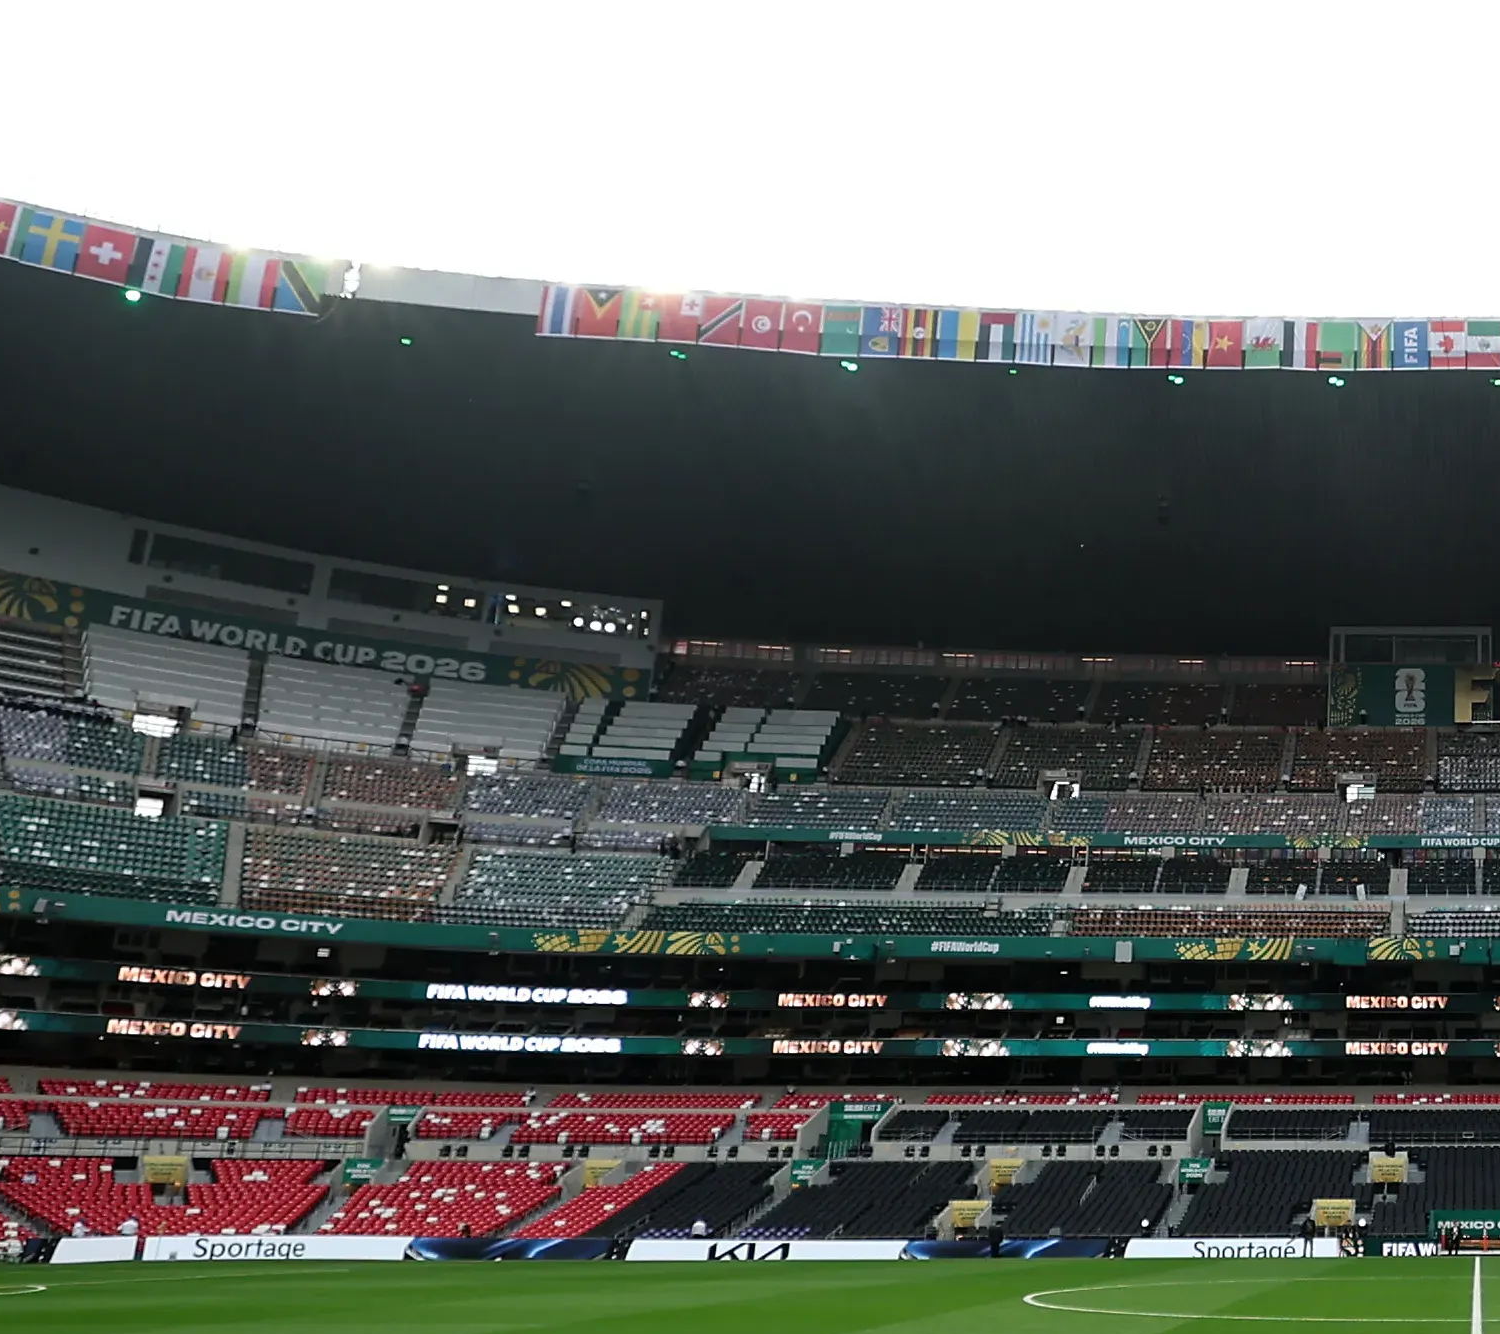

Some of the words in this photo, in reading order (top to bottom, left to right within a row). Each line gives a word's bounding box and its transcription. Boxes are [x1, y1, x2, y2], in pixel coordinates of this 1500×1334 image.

[1404, 327, 1418, 363] FIFA
[109, 605, 182, 636] FIFA
[190, 619, 307, 657] WORLD
[313, 640, 378, 664] CUP
[380, 650, 488, 682] 2026
[1124, 836, 1186, 846] MEXICO
[1188, 836, 1226, 846] CITY
[1421, 837, 1443, 846] FIFA
[1443, 837, 1476, 847] WORLD
[1477, 837, 1500, 847] CUP
[165, 910, 276, 930] MEXICO
[279, 918, 344, 935] CITY
[930, 941, 999, 954] #FIFAWorldCup
[117, 965, 197, 986] MEXICO
[199, 972, 252, 990] CITY
[426, 983, 467, 1000] FIFA
[467, 985, 531, 1003] WORLD
[532, 988, 567, 1003] CUP
[778, 993, 845, 1007] MEXICO
[848, 994, 888, 1007] CITY
[1345, 995, 1409, 1009] MEXICO
[1411, 995, 1449, 1009] CITY
[190, 1023, 243, 1040] CITY
[418, 1034, 459, 1050] FIFA
[459, 1035, 524, 1051] WORLD
[524, 1037, 561, 1052] CUP
[772, 1040, 841, 1054] MEXICO
[843, 1040, 883, 1054] CITY
[1345, 1042, 1409, 1056] MEXICO
[1411, 1042, 1449, 1056] CITY
[193, 1238, 305, 1259] Sportage
[708, 1243, 789, 1259] KIA
[1193, 1241, 1295, 1257] Sportage
[1382, 1242, 1418, 1257] FIFA
